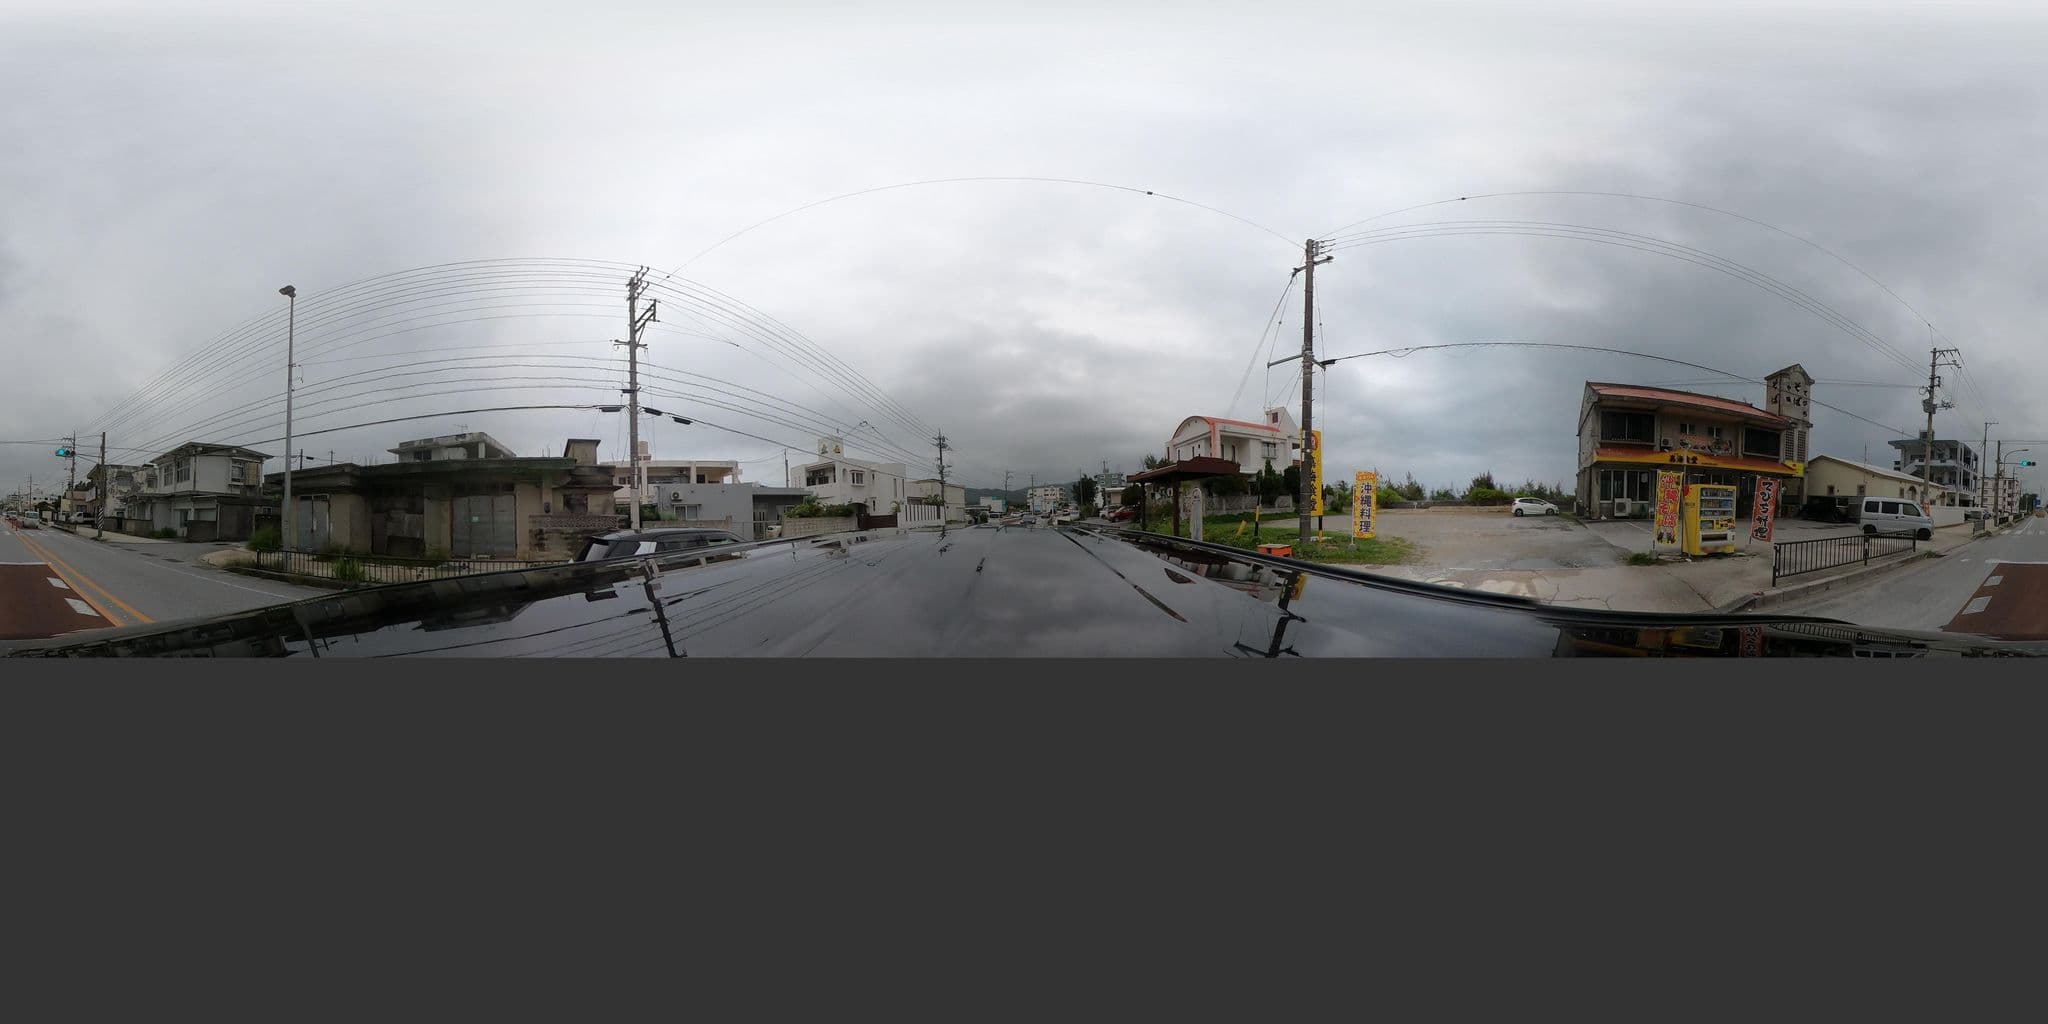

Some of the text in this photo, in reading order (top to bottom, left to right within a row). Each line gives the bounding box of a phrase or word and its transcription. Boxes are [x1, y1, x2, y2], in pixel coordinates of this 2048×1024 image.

[1793, 382, 1803, 407] そば
[1359, 482, 1372, 533] 沖縄料理
[1754, 481, 1773, 539] てびち料理
